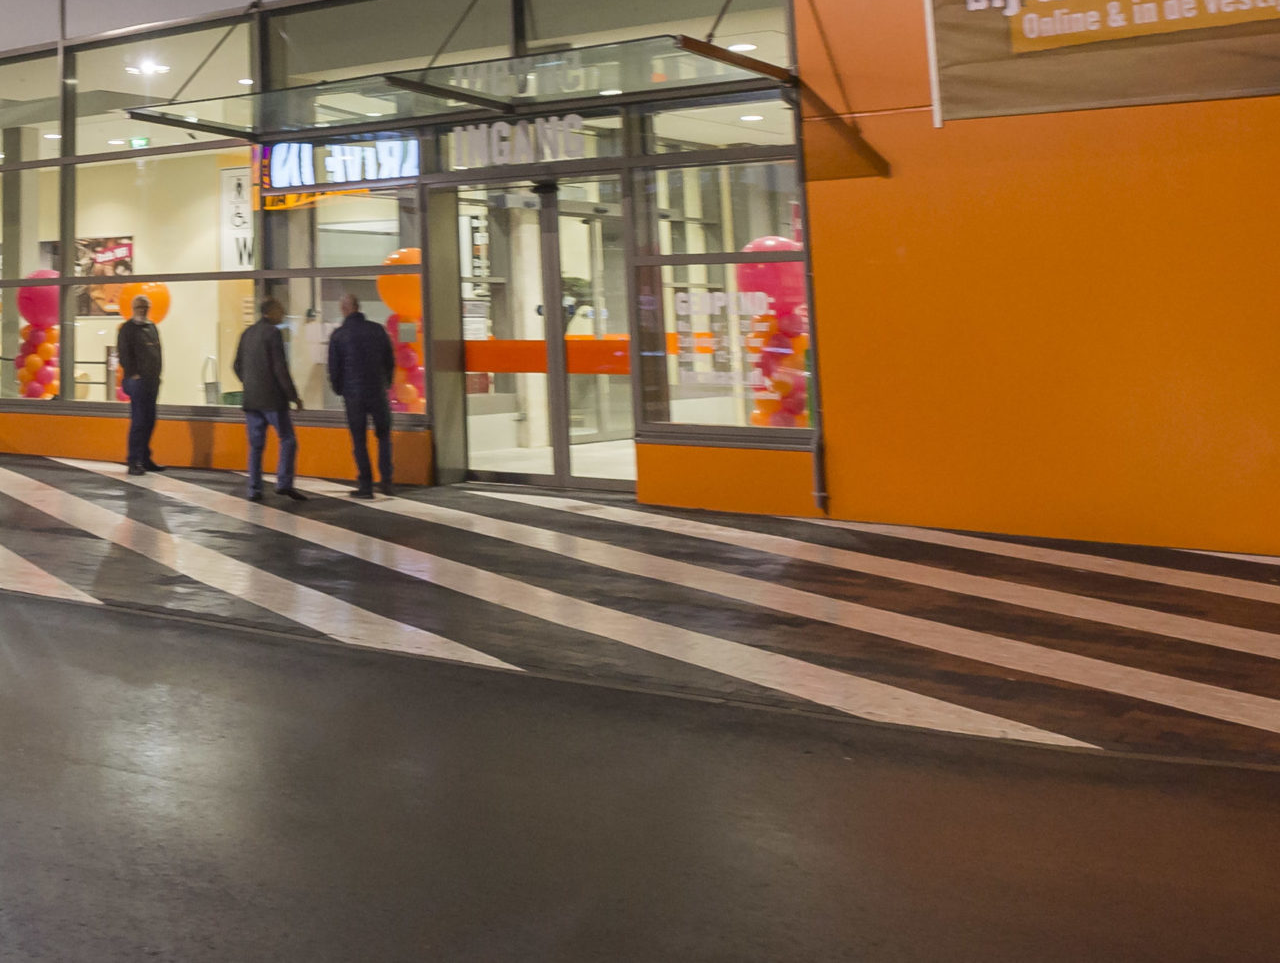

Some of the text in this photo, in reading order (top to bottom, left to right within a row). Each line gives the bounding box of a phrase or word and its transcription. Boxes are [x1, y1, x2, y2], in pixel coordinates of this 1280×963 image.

[1023, 9, 1101, 38] Online
[1106, 1, 1127, 27] &
[452, 114, 585, 167] INGANG
